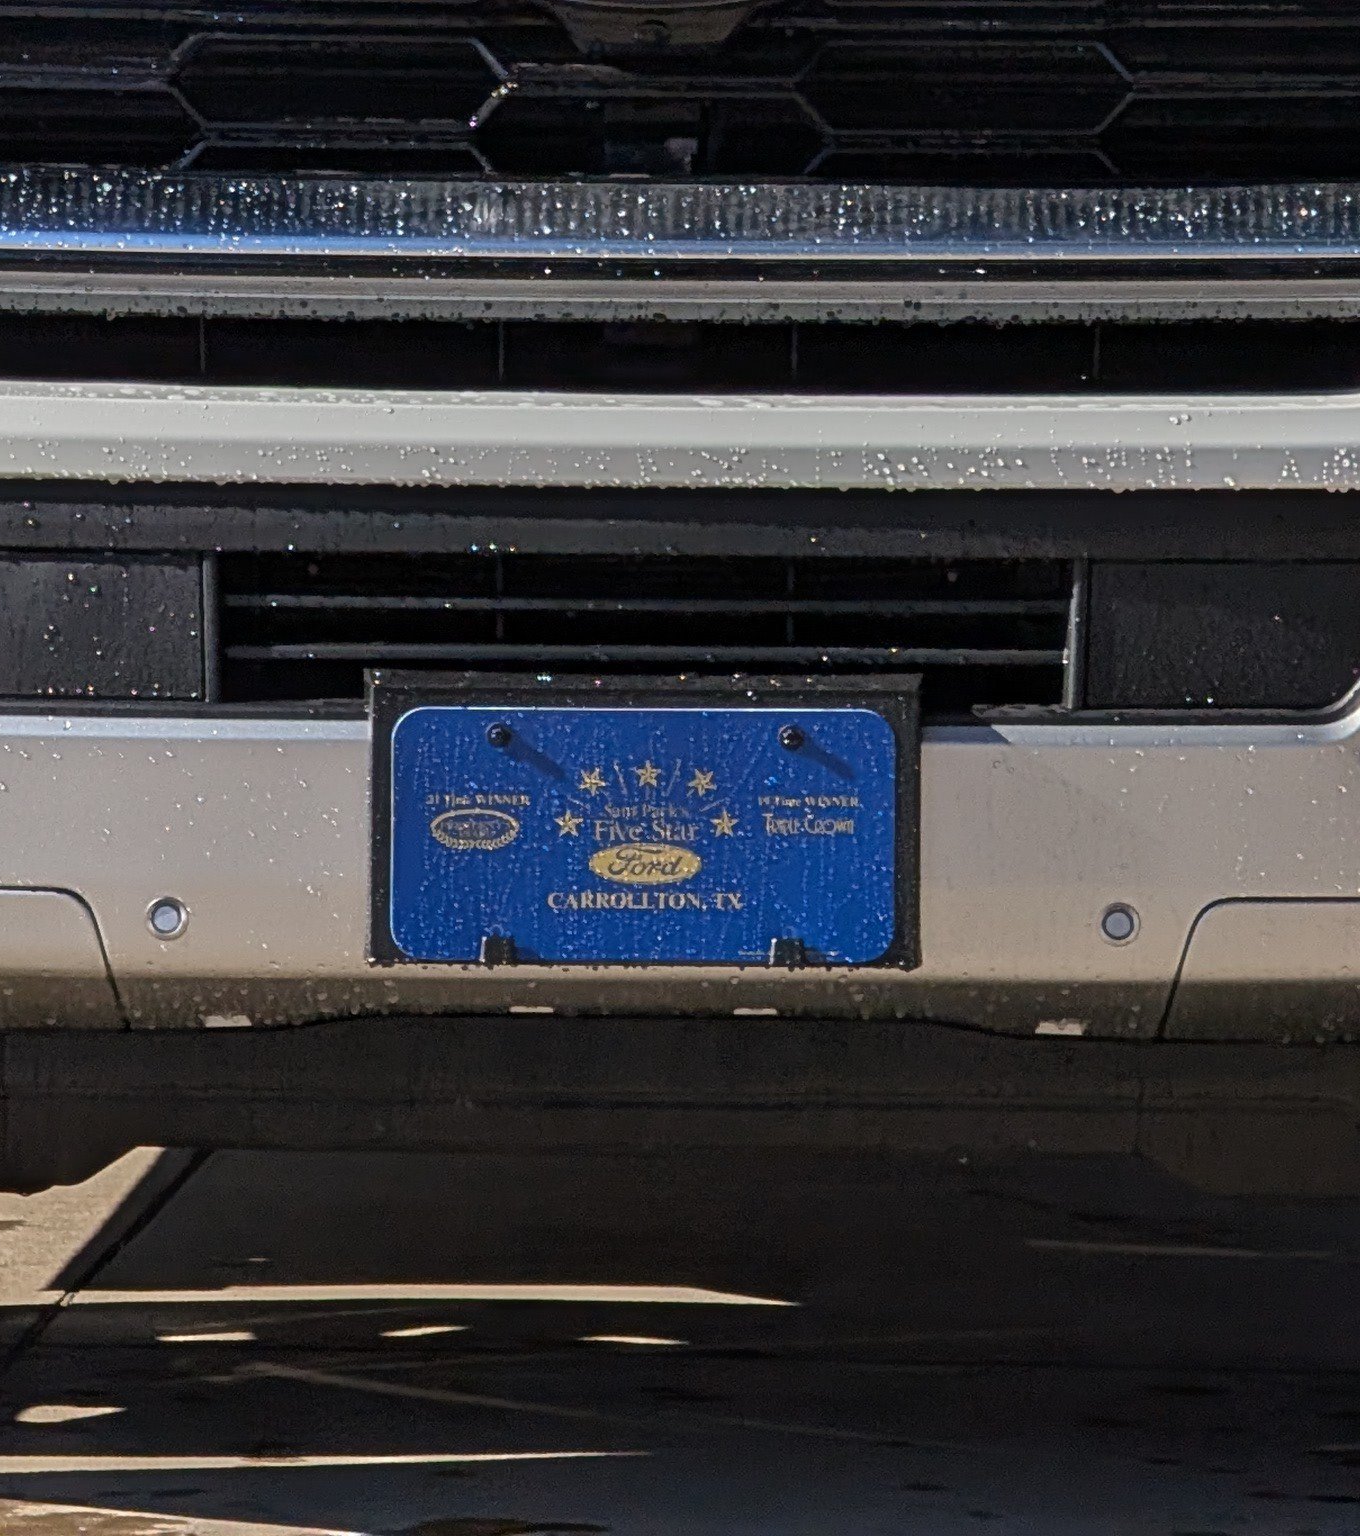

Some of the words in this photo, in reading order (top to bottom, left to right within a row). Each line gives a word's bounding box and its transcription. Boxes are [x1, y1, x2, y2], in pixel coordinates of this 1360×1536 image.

[593, 818, 643, 841] Five
[652, 818, 700, 841] Star
[607, 846, 683, 876] Ford
[714, 891, 745, 910] TX
